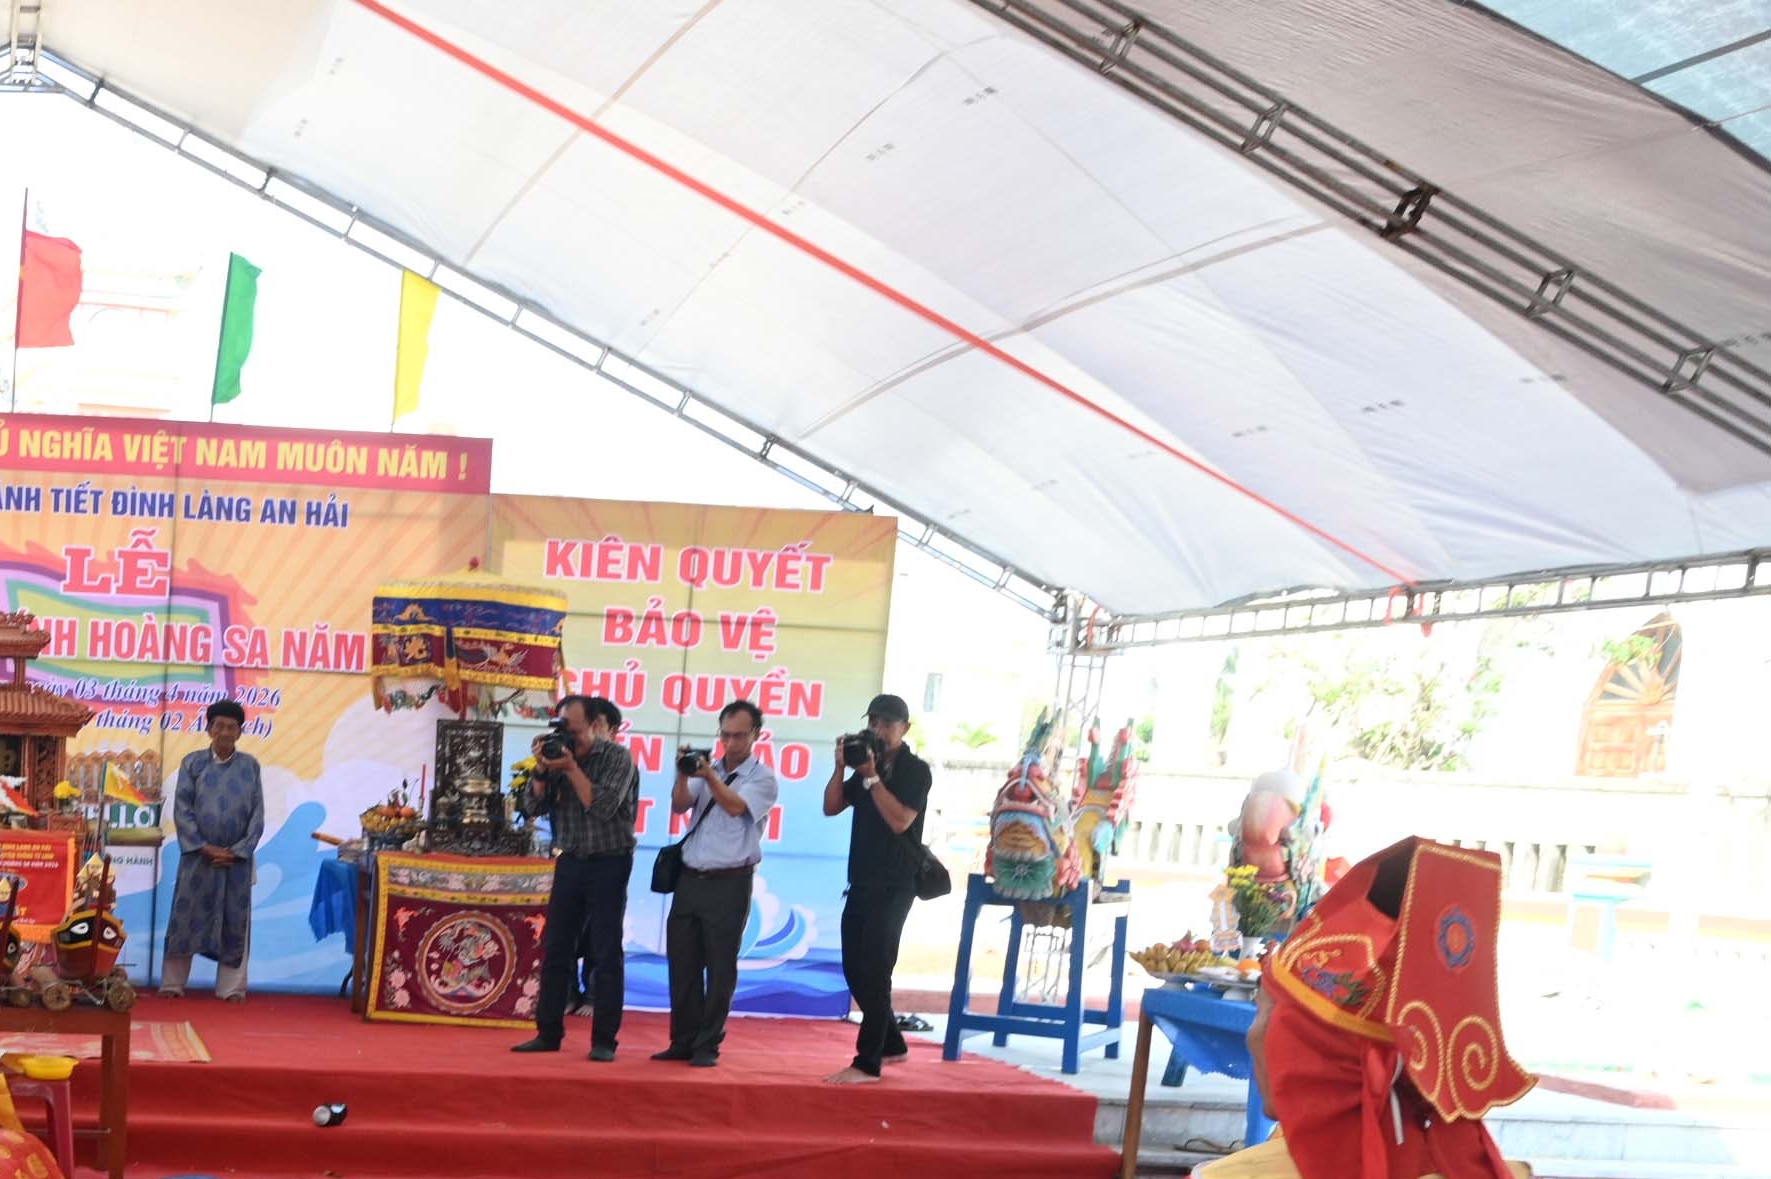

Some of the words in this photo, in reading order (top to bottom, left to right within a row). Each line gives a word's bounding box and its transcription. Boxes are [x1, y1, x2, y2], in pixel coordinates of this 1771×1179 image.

[19, 428, 113, 463] NGHĨA
[124, 430, 186, 471] VIỆT
[196, 437, 267, 470] NAM
[277, 439, 368, 475] MUÔN
[378, 445, 448, 480] NĂM
[51, 479, 104, 514] TIẾT
[111, 487, 175, 518] ĐÌNH
[184, 490, 251, 522] LÀNG
[260, 499, 297, 525] AN
[305, 492, 349, 528] HẢI
[60, 527, 172, 597] LỄ
[544, 535, 664, 582] KIÊN
[679, 542, 833, 593] QUYẾT
[89, 611, 213, 664] HOÀNG
[222, 625, 270, 668] SA
[282, 622, 366, 674] NĂM
[603, 598, 706, 649] BẢO
[720, 609, 779, 661] VỆ
[75, 678, 98, 699] 03
[104, 679, 163, 706] tháng
[166, 681, 180, 702] 4
[184, 683, 228, 704] năm
[234, 686, 283, 707] 2026
[662, 667, 822, 718] QUYỀN
[96, 708, 154, 735] tháng
[160, 711, 184, 730] 02
